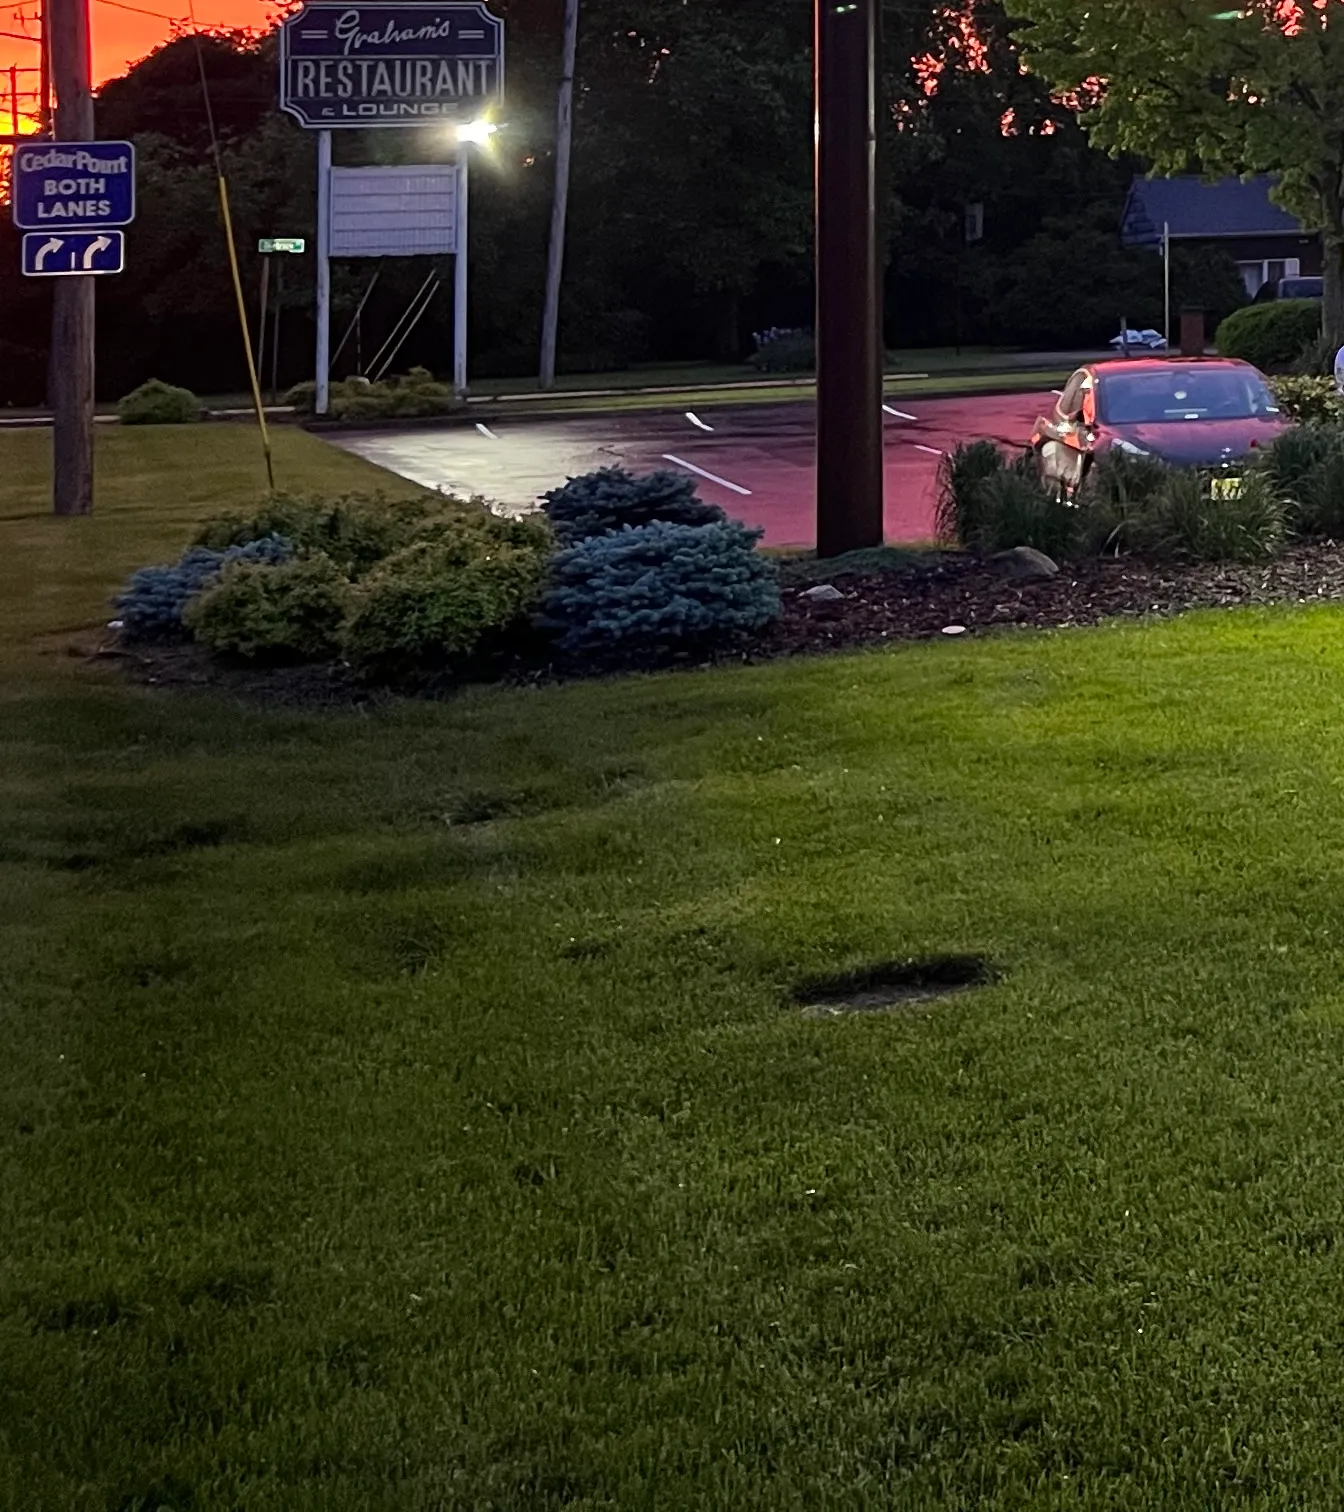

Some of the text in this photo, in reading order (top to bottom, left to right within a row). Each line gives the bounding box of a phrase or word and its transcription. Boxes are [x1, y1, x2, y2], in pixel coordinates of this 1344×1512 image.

[334, 9, 451, 55] Graham's
[297, 59, 494, 98] RESTAURANT
[342, 102, 459, 116] LOUNGE
[43, 178, 106, 196] BOTH
[37, 199, 112, 218] LANES
